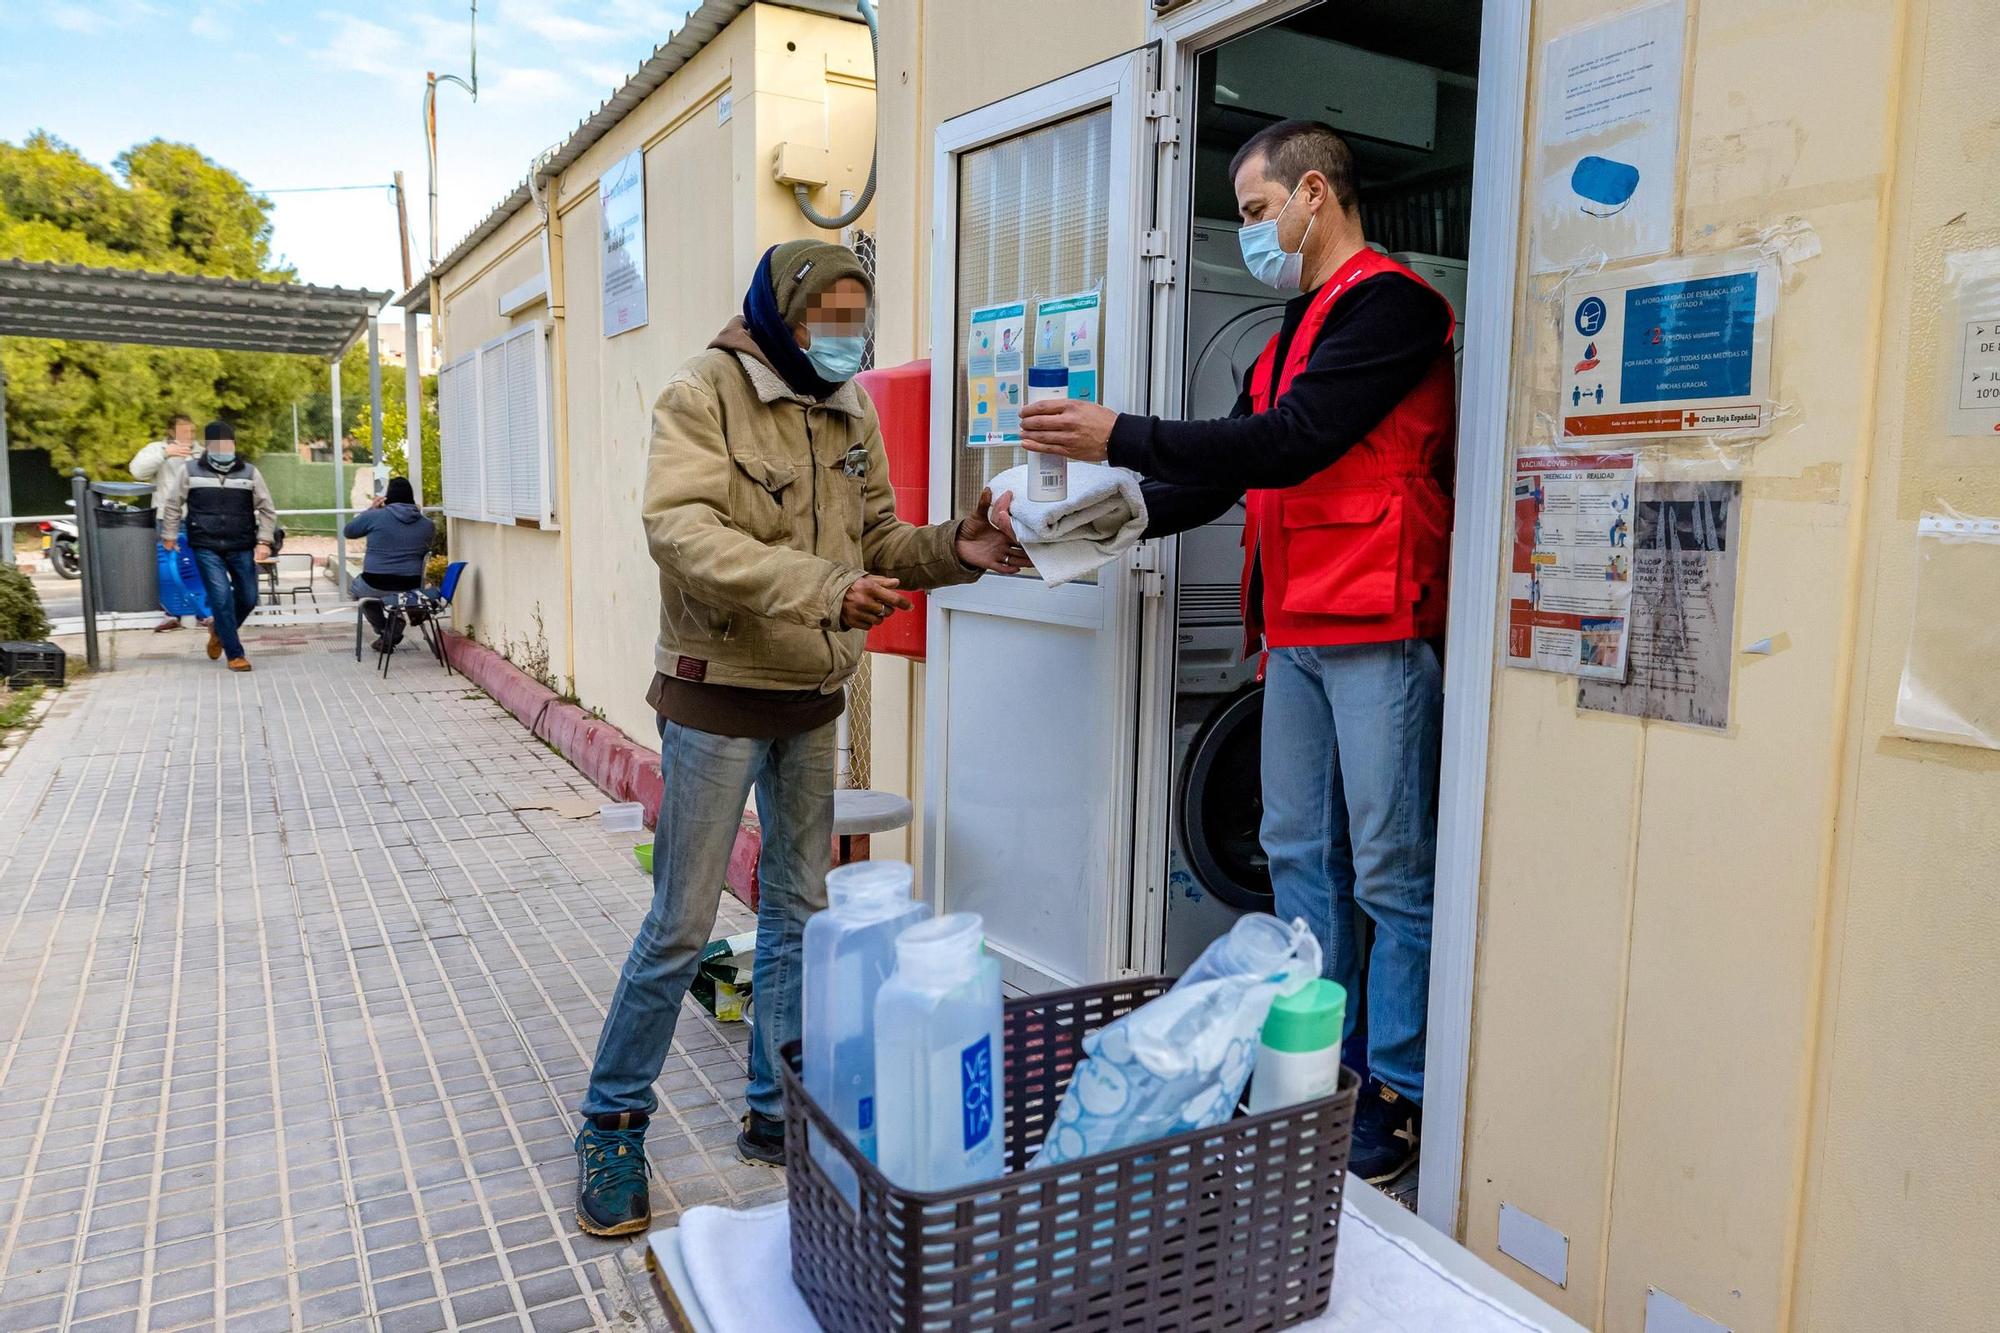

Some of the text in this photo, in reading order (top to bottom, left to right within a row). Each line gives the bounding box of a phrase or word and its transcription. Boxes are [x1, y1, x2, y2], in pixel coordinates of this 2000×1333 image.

[1642, 296, 1661, 306] AFORO
[1687, 291, 1694, 299] DE
[1711, 288, 1729, 297] LOCAL
[1670, 301, 1699, 310] LIMITADO
[1651, 326, 1720, 345] 2 PERSONAS visitantes
[1980, 342, 1996, 352] DE
[1624, 360, 1635, 368] POR
[1680, 354, 1700, 362] TODAS
[1712, 350, 1741, 360] MEDIDAS
[1656, 382, 1682, 390] MUCHAS
[1700, 412, 1758, 424] Cruz Roja Española
[1546, 459, 1578, 468] COVID-19
[1586, 472, 1615, 480] REALIDAD
